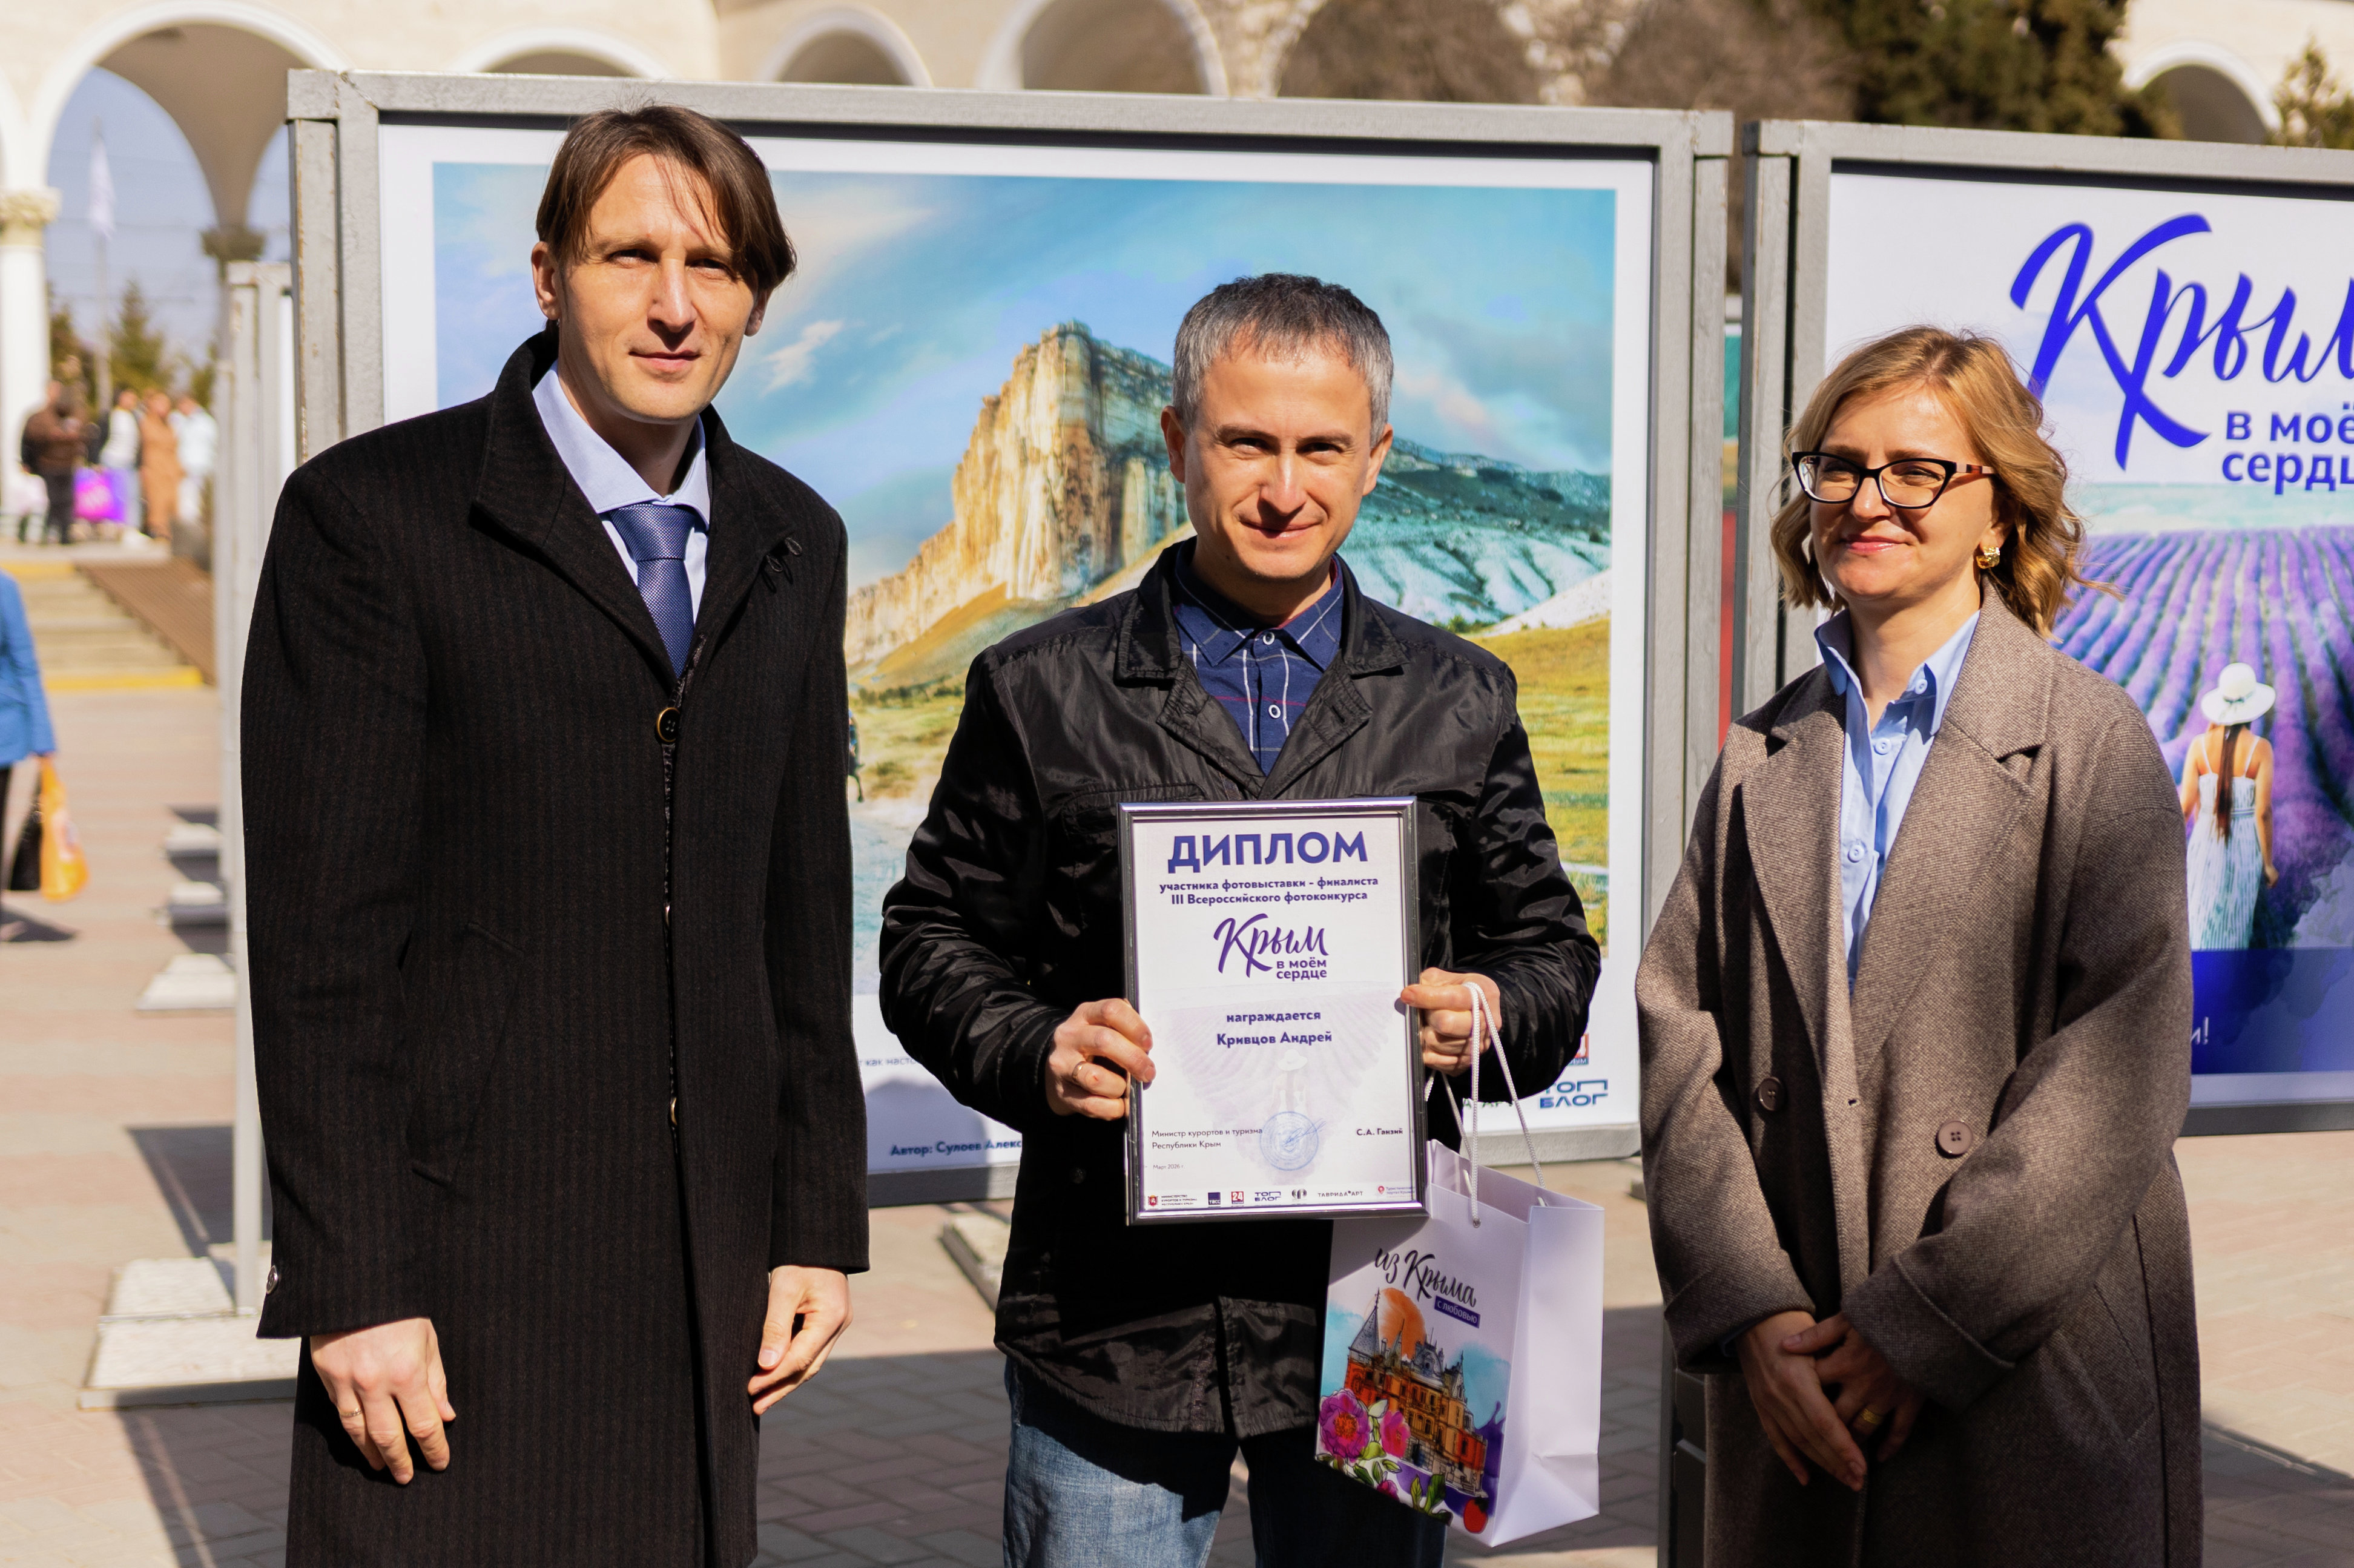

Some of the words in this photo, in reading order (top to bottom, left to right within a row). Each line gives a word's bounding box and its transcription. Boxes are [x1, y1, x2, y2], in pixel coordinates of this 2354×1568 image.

[2009, 212, 2354, 471] Кры
[2226, 411, 2252, 441] в
[1167, 831, 1368, 874] ДИПЛОМ
[1159, 881, 1219, 894] участника
[1222, 878, 1306, 893] фотовыставки
[1317, 877, 1379, 890] финалиста
[1171, 895, 1184, 904] III
[1187, 892, 1281, 906] Всероссийского
[1284, 891, 1368, 904] фотоконкурса
[1213, 913, 1330, 978] Крым
[1276, 960, 1285, 969] в
[1288, 957, 1327, 969] моём
[1276, 969, 1328, 982] сердце
[1226, 1010, 1321, 1024] награждается
[1216, 1032, 1276, 1048] Кривцов
[1280, 1031, 1332, 1046] Андрей
[1540, 1093, 1608, 1108] БЛОГ
[1232, 1128, 1263, 1137] туризма
[891, 1144, 933, 1156] Автор:
[936, 1141, 982, 1156] Сулоев
[1152, 1142, 1197, 1150] Республики
[1232, 1191, 1242, 1201] 24
[1374, 1248, 1400, 1284] из
[1403, 1250, 1477, 1308] Крыма
[1442, 1303, 1477, 1324] любовью
